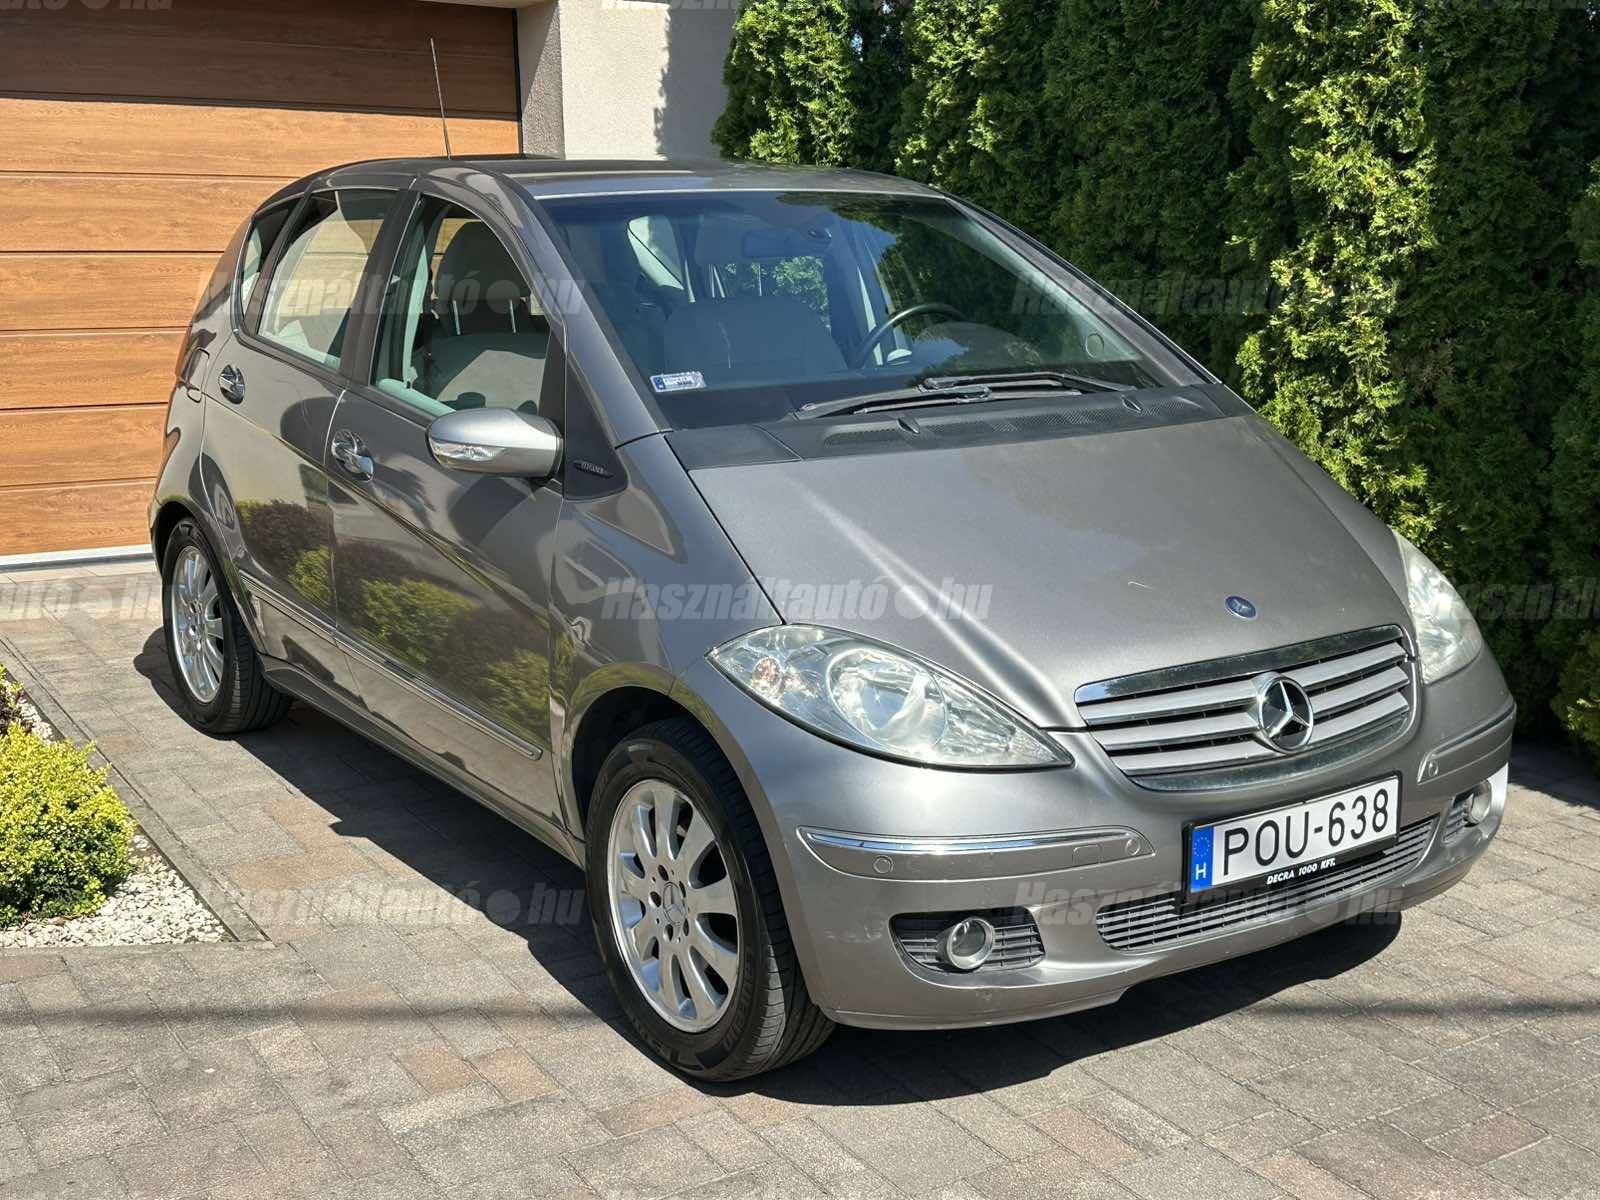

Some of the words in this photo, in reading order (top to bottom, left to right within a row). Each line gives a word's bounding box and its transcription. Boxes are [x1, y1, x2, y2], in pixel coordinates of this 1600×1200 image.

[1223, 788, 1389, 876] POU-638
[1195, 862, 1207, 880] H
[1266, 869, 1295, 885] DECRA
[1298, 863, 1318, 877] 1000
[1320, 857, 1336, 870] KFT.
